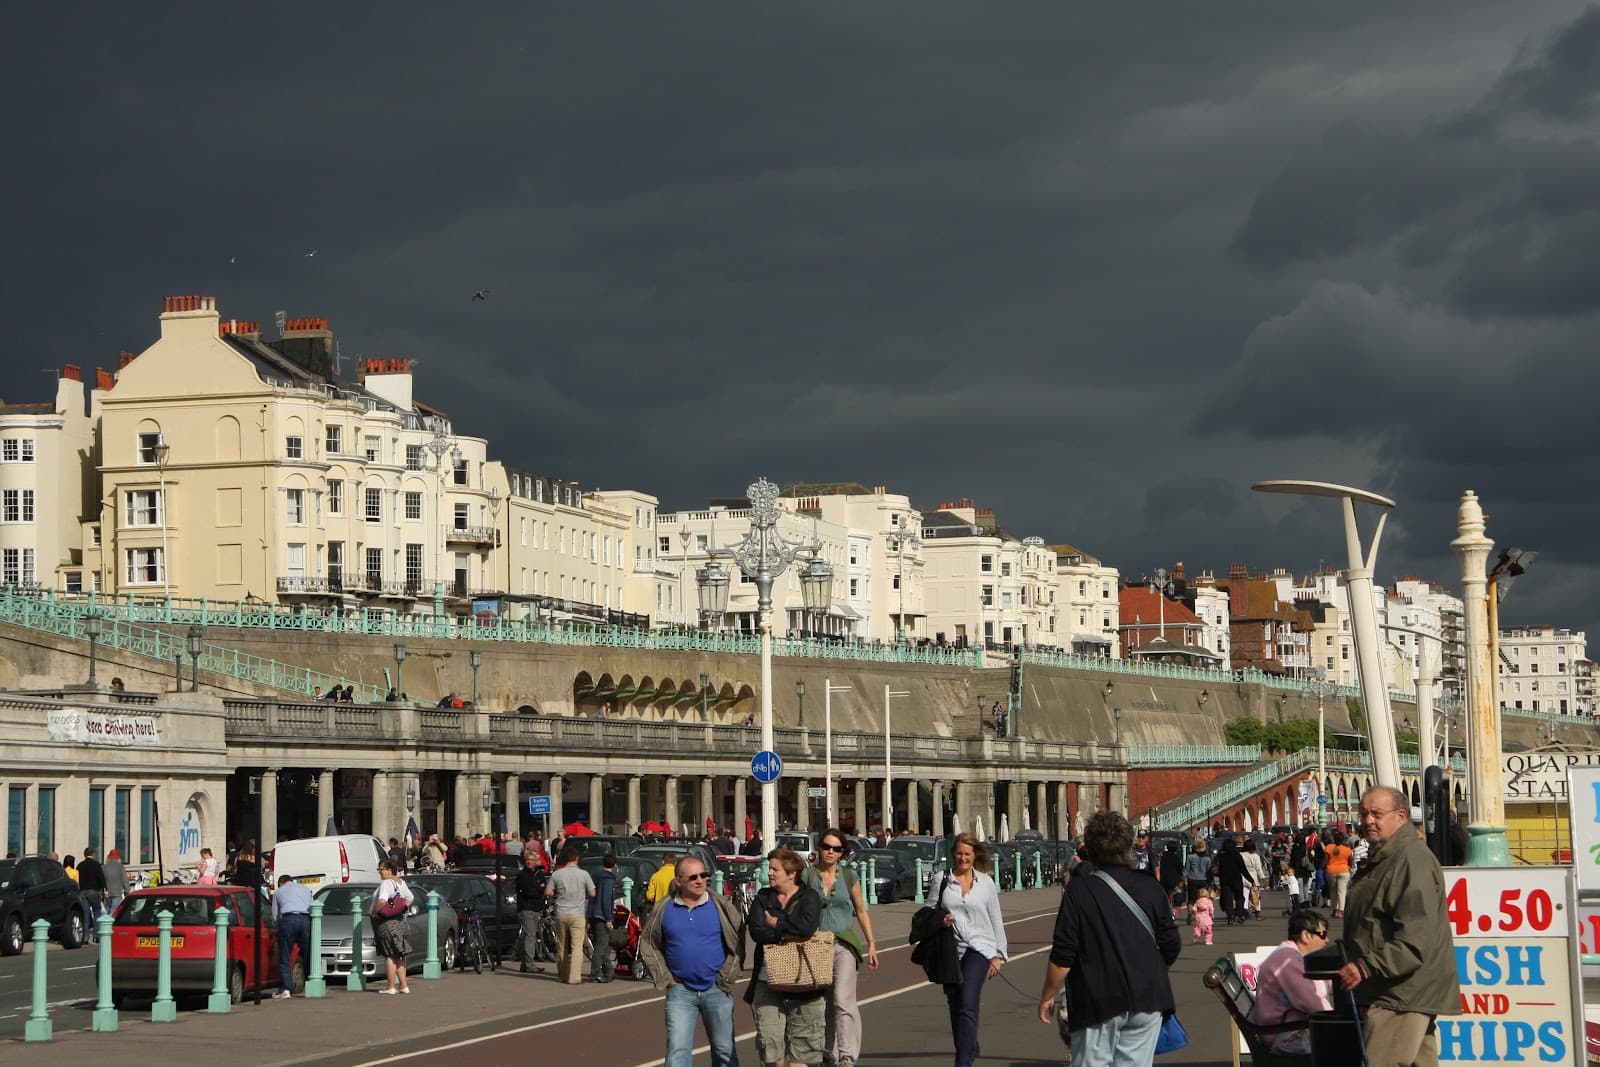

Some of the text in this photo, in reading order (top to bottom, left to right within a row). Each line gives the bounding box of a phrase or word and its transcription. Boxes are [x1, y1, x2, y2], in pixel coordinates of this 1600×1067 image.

[1454, 944, 1545, 986] ISH
[1461, 993, 1510, 1015] AND
[1436, 1019, 1566, 1062] HIPS
